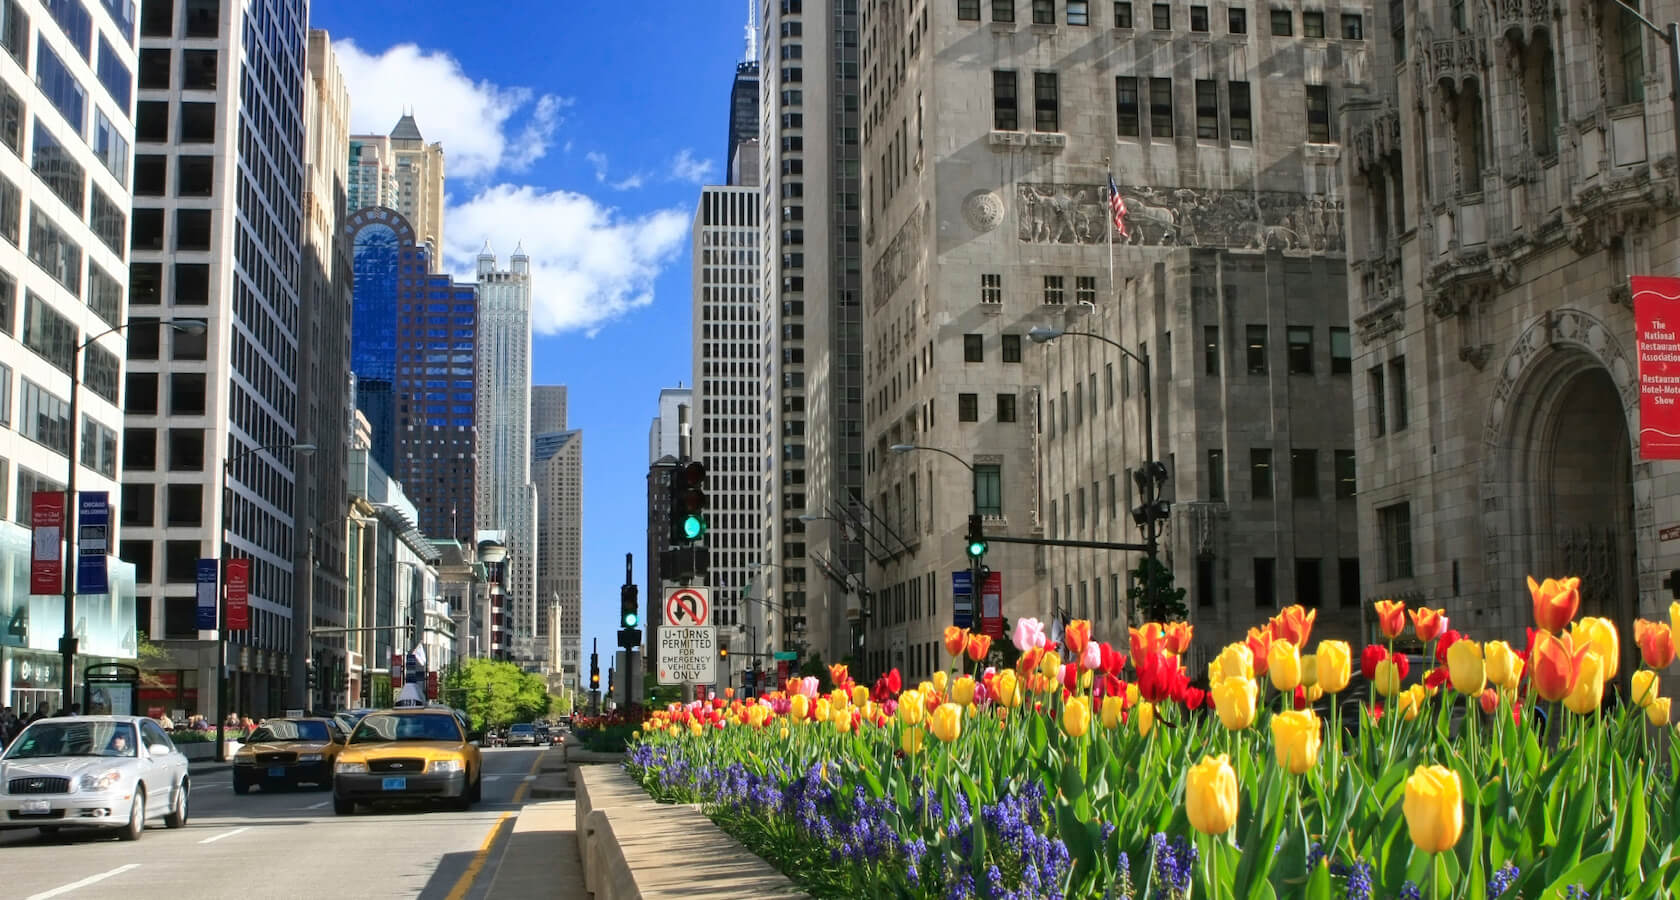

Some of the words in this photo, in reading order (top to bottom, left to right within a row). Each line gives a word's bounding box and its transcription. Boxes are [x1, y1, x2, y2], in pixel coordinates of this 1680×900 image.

[1652, 320, 1666, 330] The
[1644, 331, 1675, 341] National
[1642, 374, 1680, 383] Restauran
[1654, 395, 1675, 405] Show
[8, 605, 28, 643] 4
[664, 630, 710, 639] U-TURNS
[662, 639, 712, 649] PERMITTED
[668, 663, 707, 671] VEHICLES
[673, 671, 700, 680] ONLY
